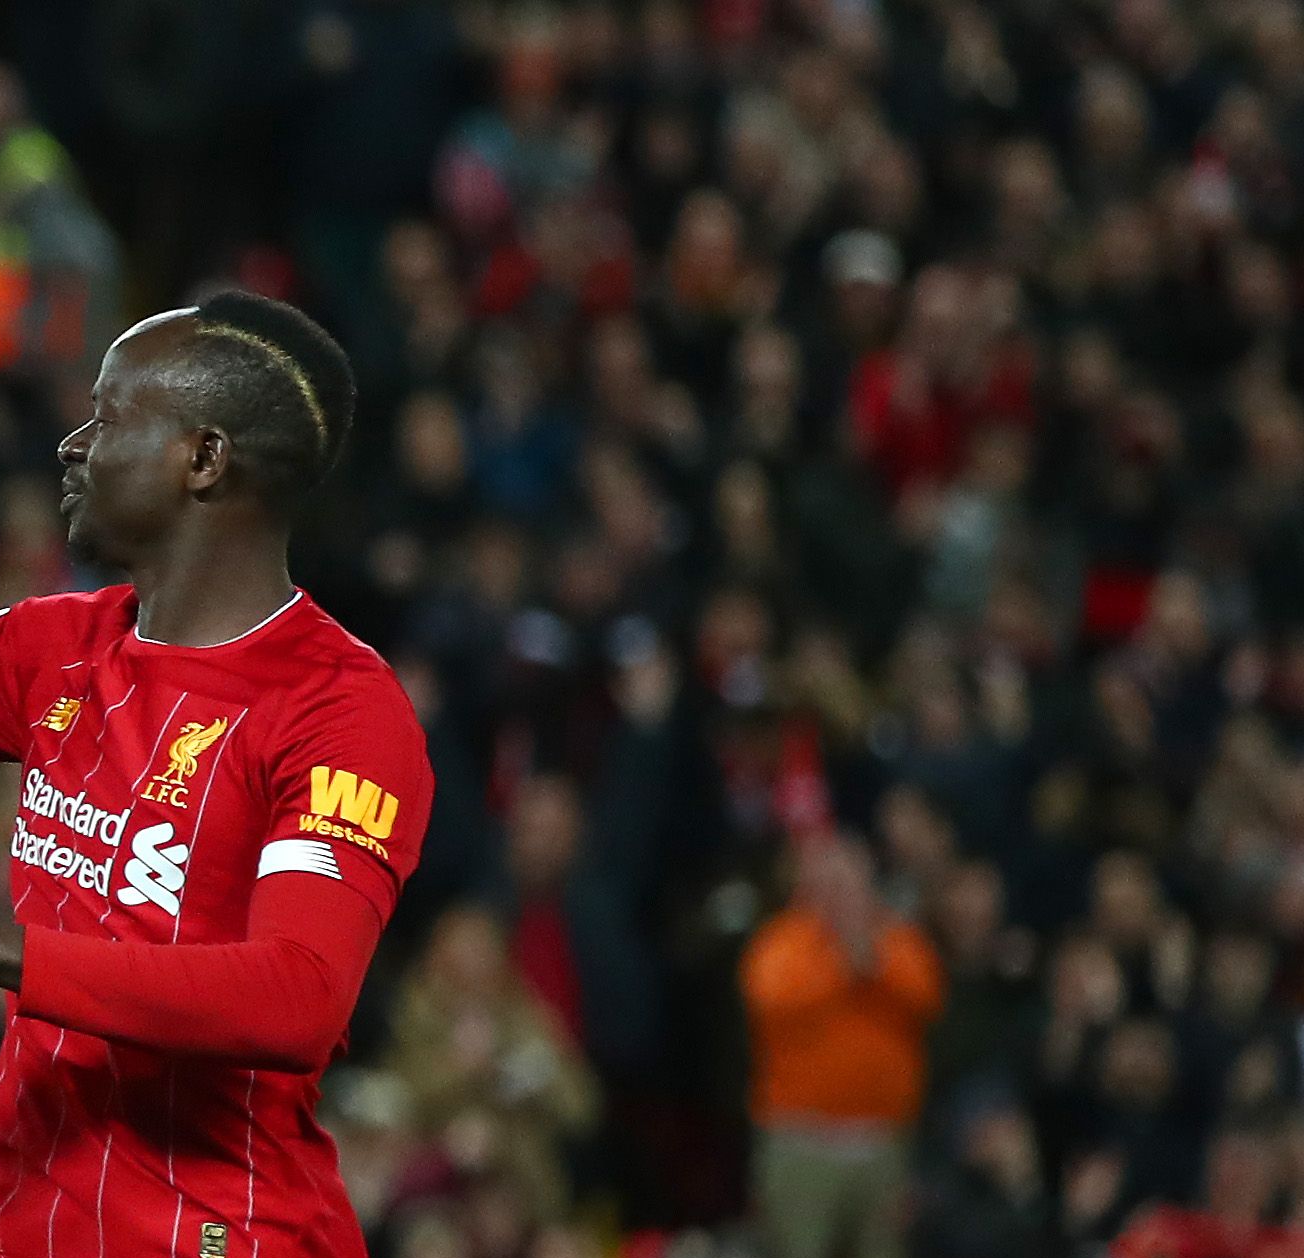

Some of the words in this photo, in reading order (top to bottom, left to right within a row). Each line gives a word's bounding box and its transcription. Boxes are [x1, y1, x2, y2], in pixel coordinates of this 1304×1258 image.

[22, 767, 131, 847] Standard
[140, 782, 189, 809] L.F.C.
[310, 765, 400, 839] WU
[298, 813, 389, 860] Western
